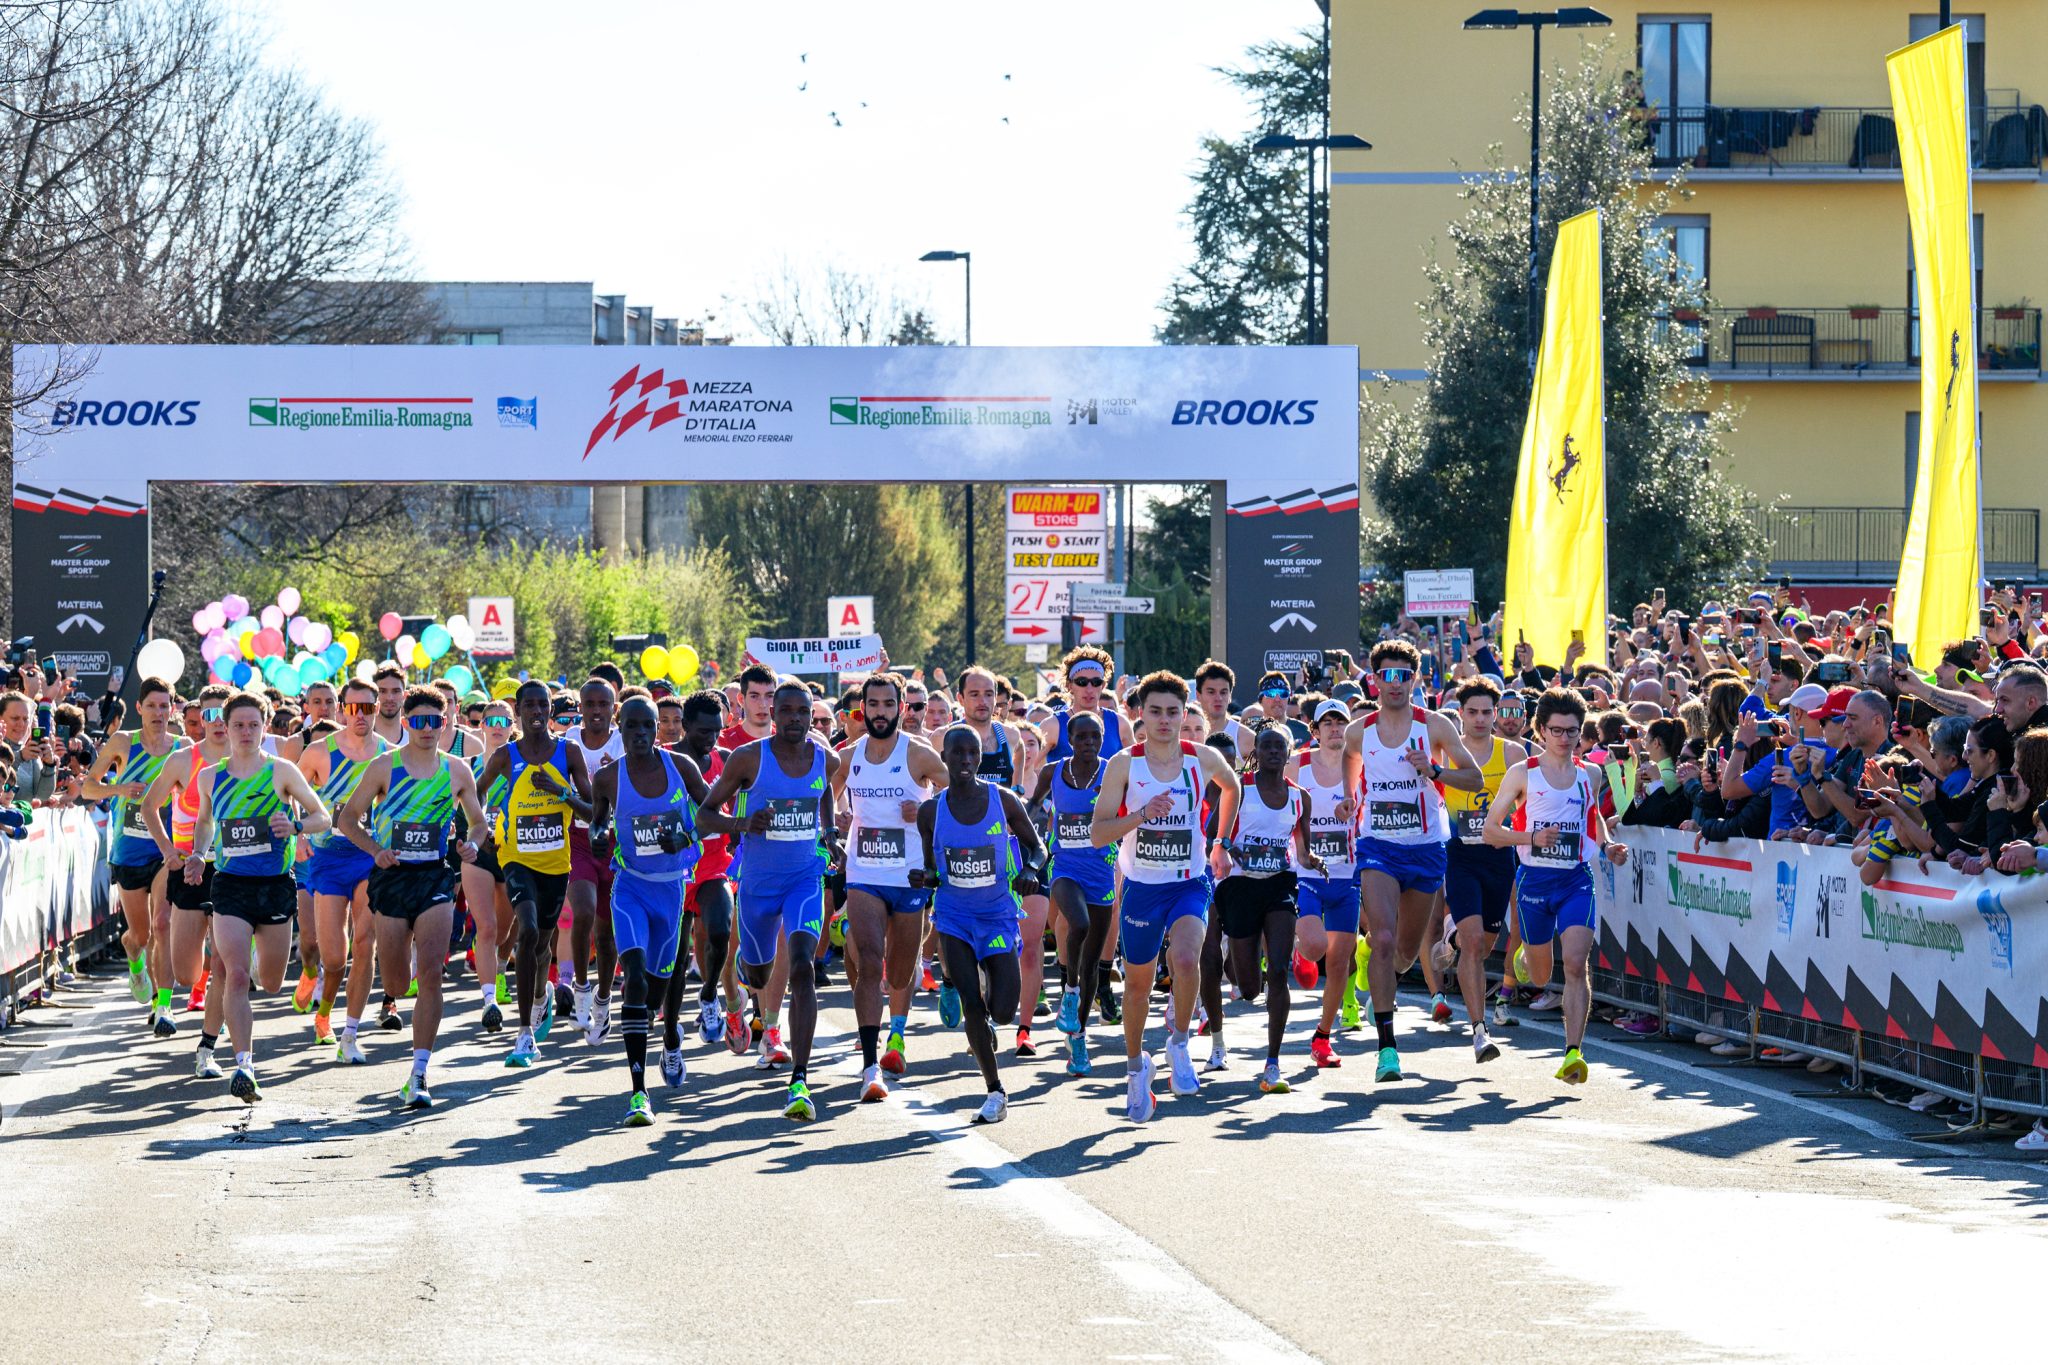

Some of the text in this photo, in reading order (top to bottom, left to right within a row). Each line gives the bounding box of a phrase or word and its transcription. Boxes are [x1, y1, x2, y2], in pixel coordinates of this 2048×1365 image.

[693, 382, 753, 394] MEZZA
[689, 400, 793, 412] MARATONA
[1102, 398, 1137, 406] MOTOR
[51, 400, 200, 426] BROOKS
[497, 406, 534, 415] SPORT
[1102, 408, 1133, 416] VALLEY
[1171, 400, 1319, 425] BROOKS
[683, 434, 793, 443] MEMORIAL ENZO FERRARI
[1014, 494, 1098, 513] WARM-UP
[1035, 514, 1078, 525] STORE
[1012, 536, 1043, 546] PUSH
[1063, 536, 1100, 546] START
[1013, 553, 1099, 567] TEST DRIVE
[1264, 558, 1322, 566] MASTER GROUP
[68, 567, 93, 575] SPORT
[1010, 580, 1049, 615] 27
[1055, 593, 1070, 601] PIZ
[1438, 592, 1463, 600] Ferrari
[57, 601, 103, 609] MATERIA
[1048, 605, 1070, 613] RISTO
[1270, 600, 1316, 609] MATERIA
[482, 604, 502, 626] A
[841, 604, 860, 626] A
[766, 639, 861, 652] GIOIA DEL COLLE
[56, 654, 106, 663] PARMIGIANO
[1269, 653, 1318, 662] PARMIGIANO
[1371, 812, 1421, 826] FRANCIA
[1468, 817, 1485, 830] 82
[231, 826, 256, 839] 870
[404, 830, 430, 843] 873
[517, 825, 563, 841] EKIDOR
[862, 841, 899, 854] OUHDA
[1136, 841, 1191, 857] CORNALI
[1643, 850, 1657, 866] MOTOR
[950, 859, 991, 874] KOSGEI
[1831, 876, 1847, 894] MOTOR
